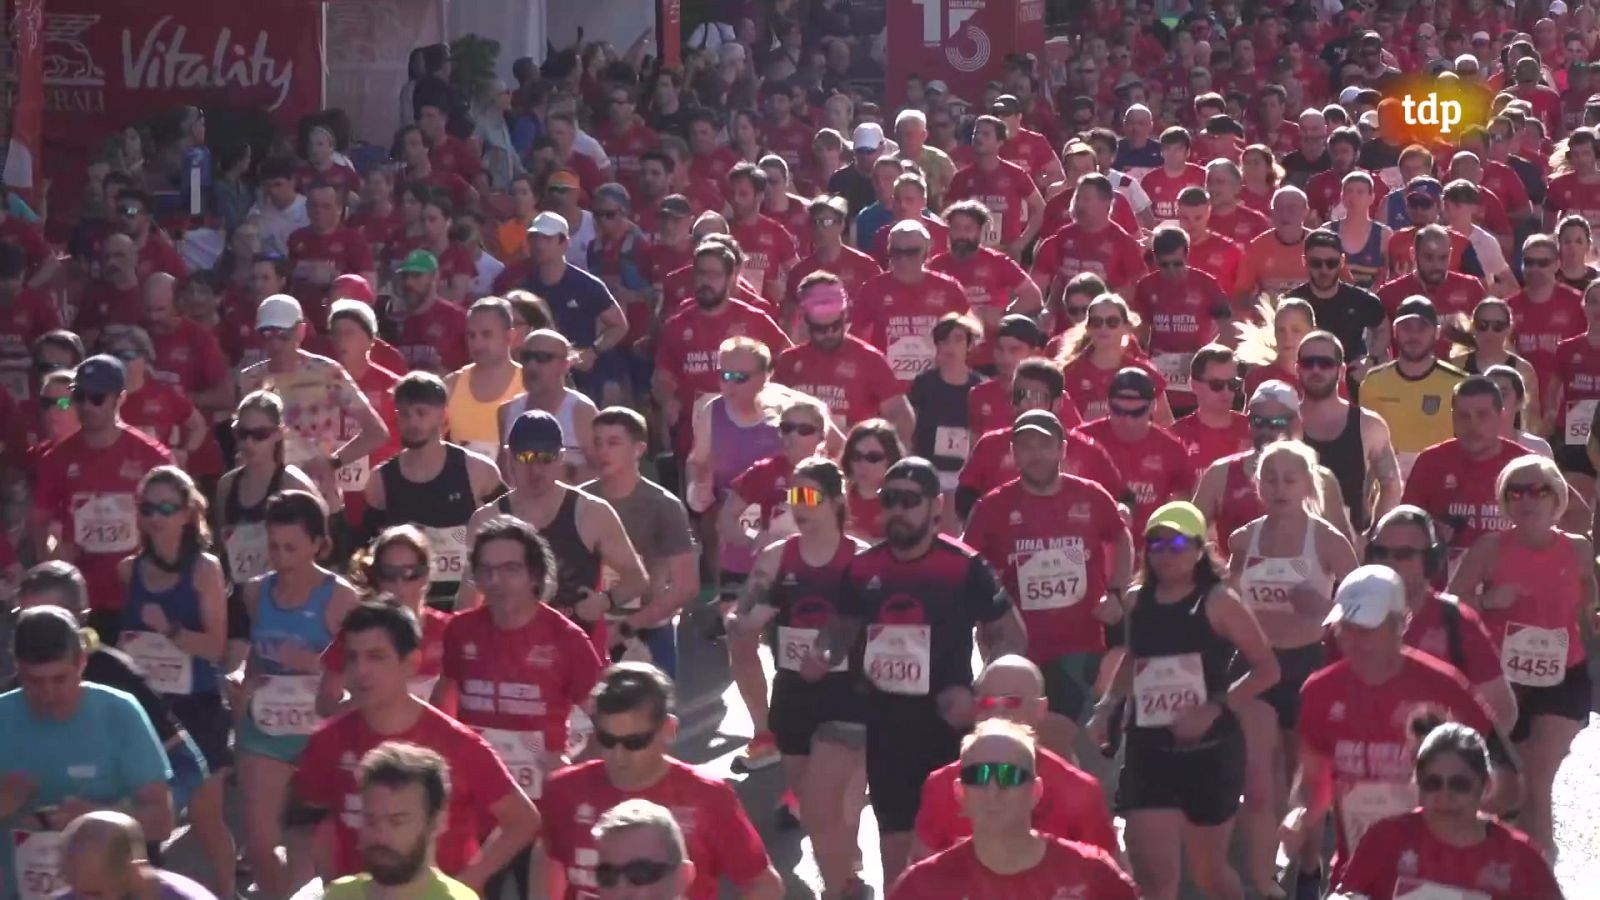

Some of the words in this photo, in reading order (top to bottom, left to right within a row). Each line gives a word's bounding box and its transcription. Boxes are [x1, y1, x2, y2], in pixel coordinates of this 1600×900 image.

[121, 16, 293, 112] Vitality
[893, 359, 932, 372] 2202
[1448, 503, 1477, 516] UNA
[1481, 504, 1500, 516] ME
[1016, 538, 1044, 551] UNA
[1027, 576, 1079, 600] 5547
[1507, 656, 1560, 677] 4455
[1143, 689, 1199, 714] 2429
